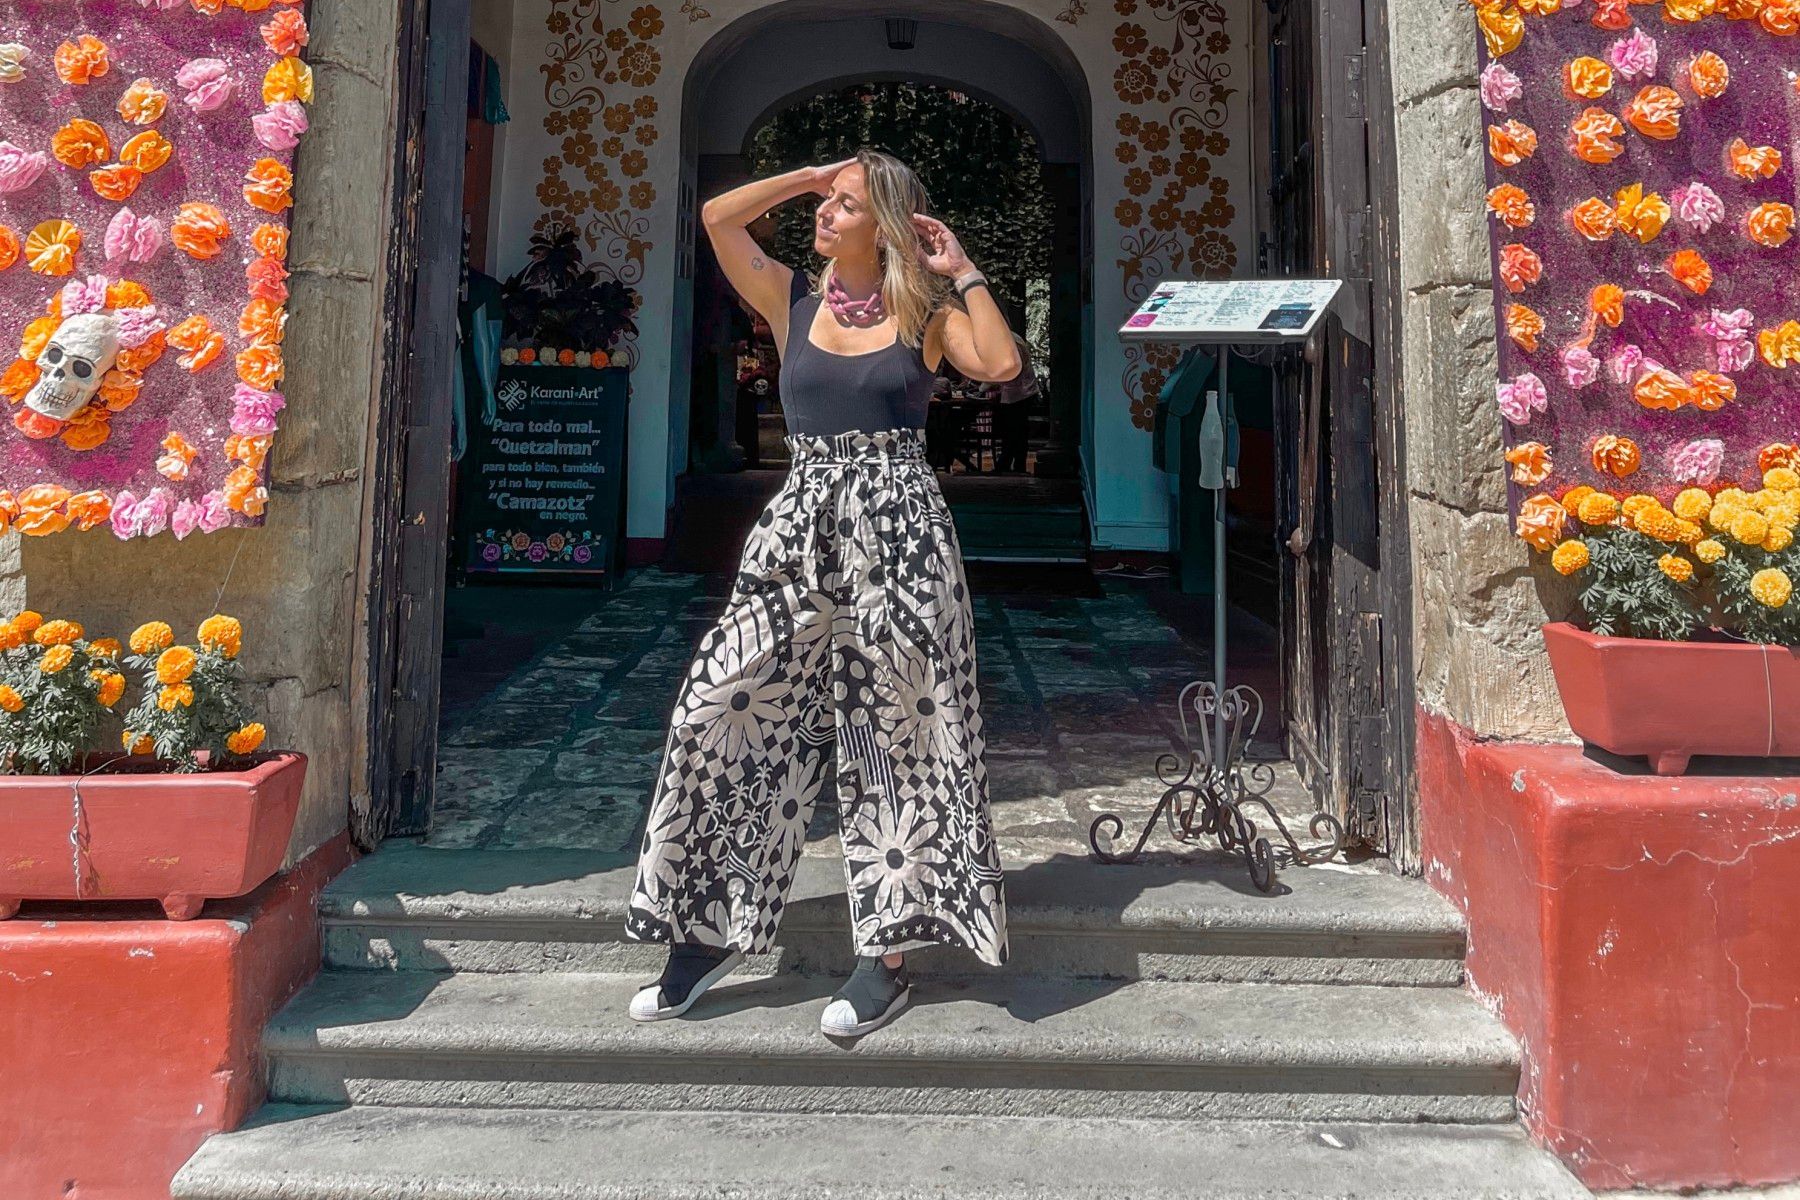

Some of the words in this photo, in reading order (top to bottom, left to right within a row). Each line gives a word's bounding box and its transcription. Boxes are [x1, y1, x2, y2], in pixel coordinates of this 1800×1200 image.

[491, 418, 524, 432] Para
[528, 419, 562, 433] todo
[482, 462, 506, 474] para
[508, 462, 532, 472] todo
[534, 462, 560, 474] bien,
[562, 462, 605, 474] también
[488, 479, 496, 490] y
[509, 479, 522, 488] no
[525, 477, 544, 491] hay
[539, 511, 553, 520] en
[555, 511, 588, 523] negro.
